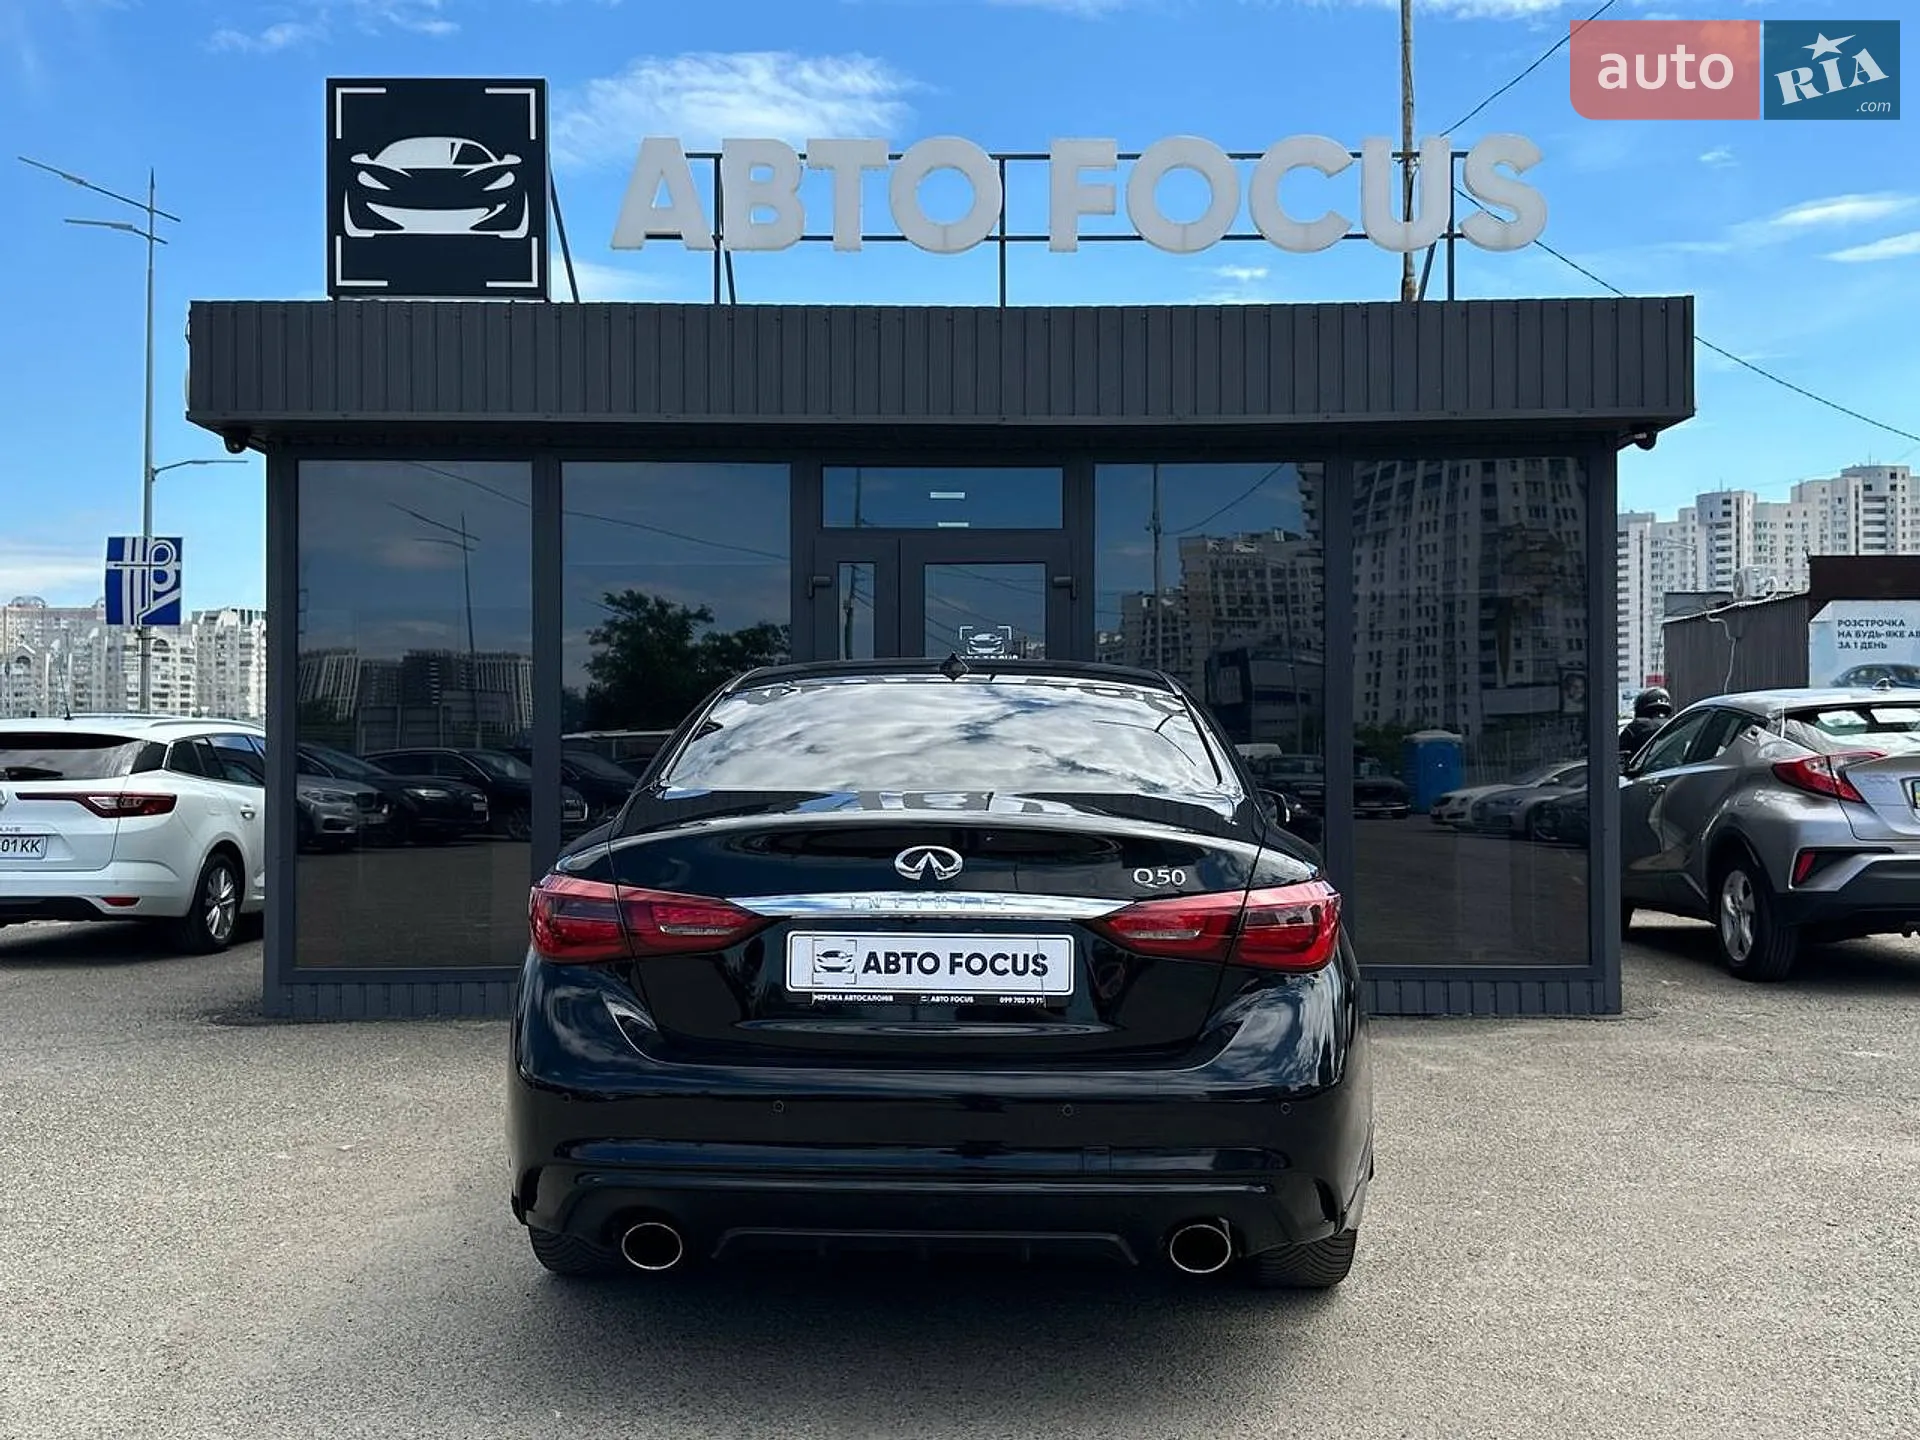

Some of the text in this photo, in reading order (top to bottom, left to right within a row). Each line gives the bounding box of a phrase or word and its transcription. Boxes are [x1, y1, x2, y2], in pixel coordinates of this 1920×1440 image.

[610, 134, 1548, 254] АВТО FOCUS
[1837, 619, 1905, 627] РОЗСТРОЧКА
[1837, 630, 1852, 638] НА
[1837, 641, 1851, 649] ЗА
[1860, 641, 1887, 650] ДЕНЬ
[1133, 868, 1186, 888] Q50
[862, 951, 1049, 976] АВТО FOCUS
